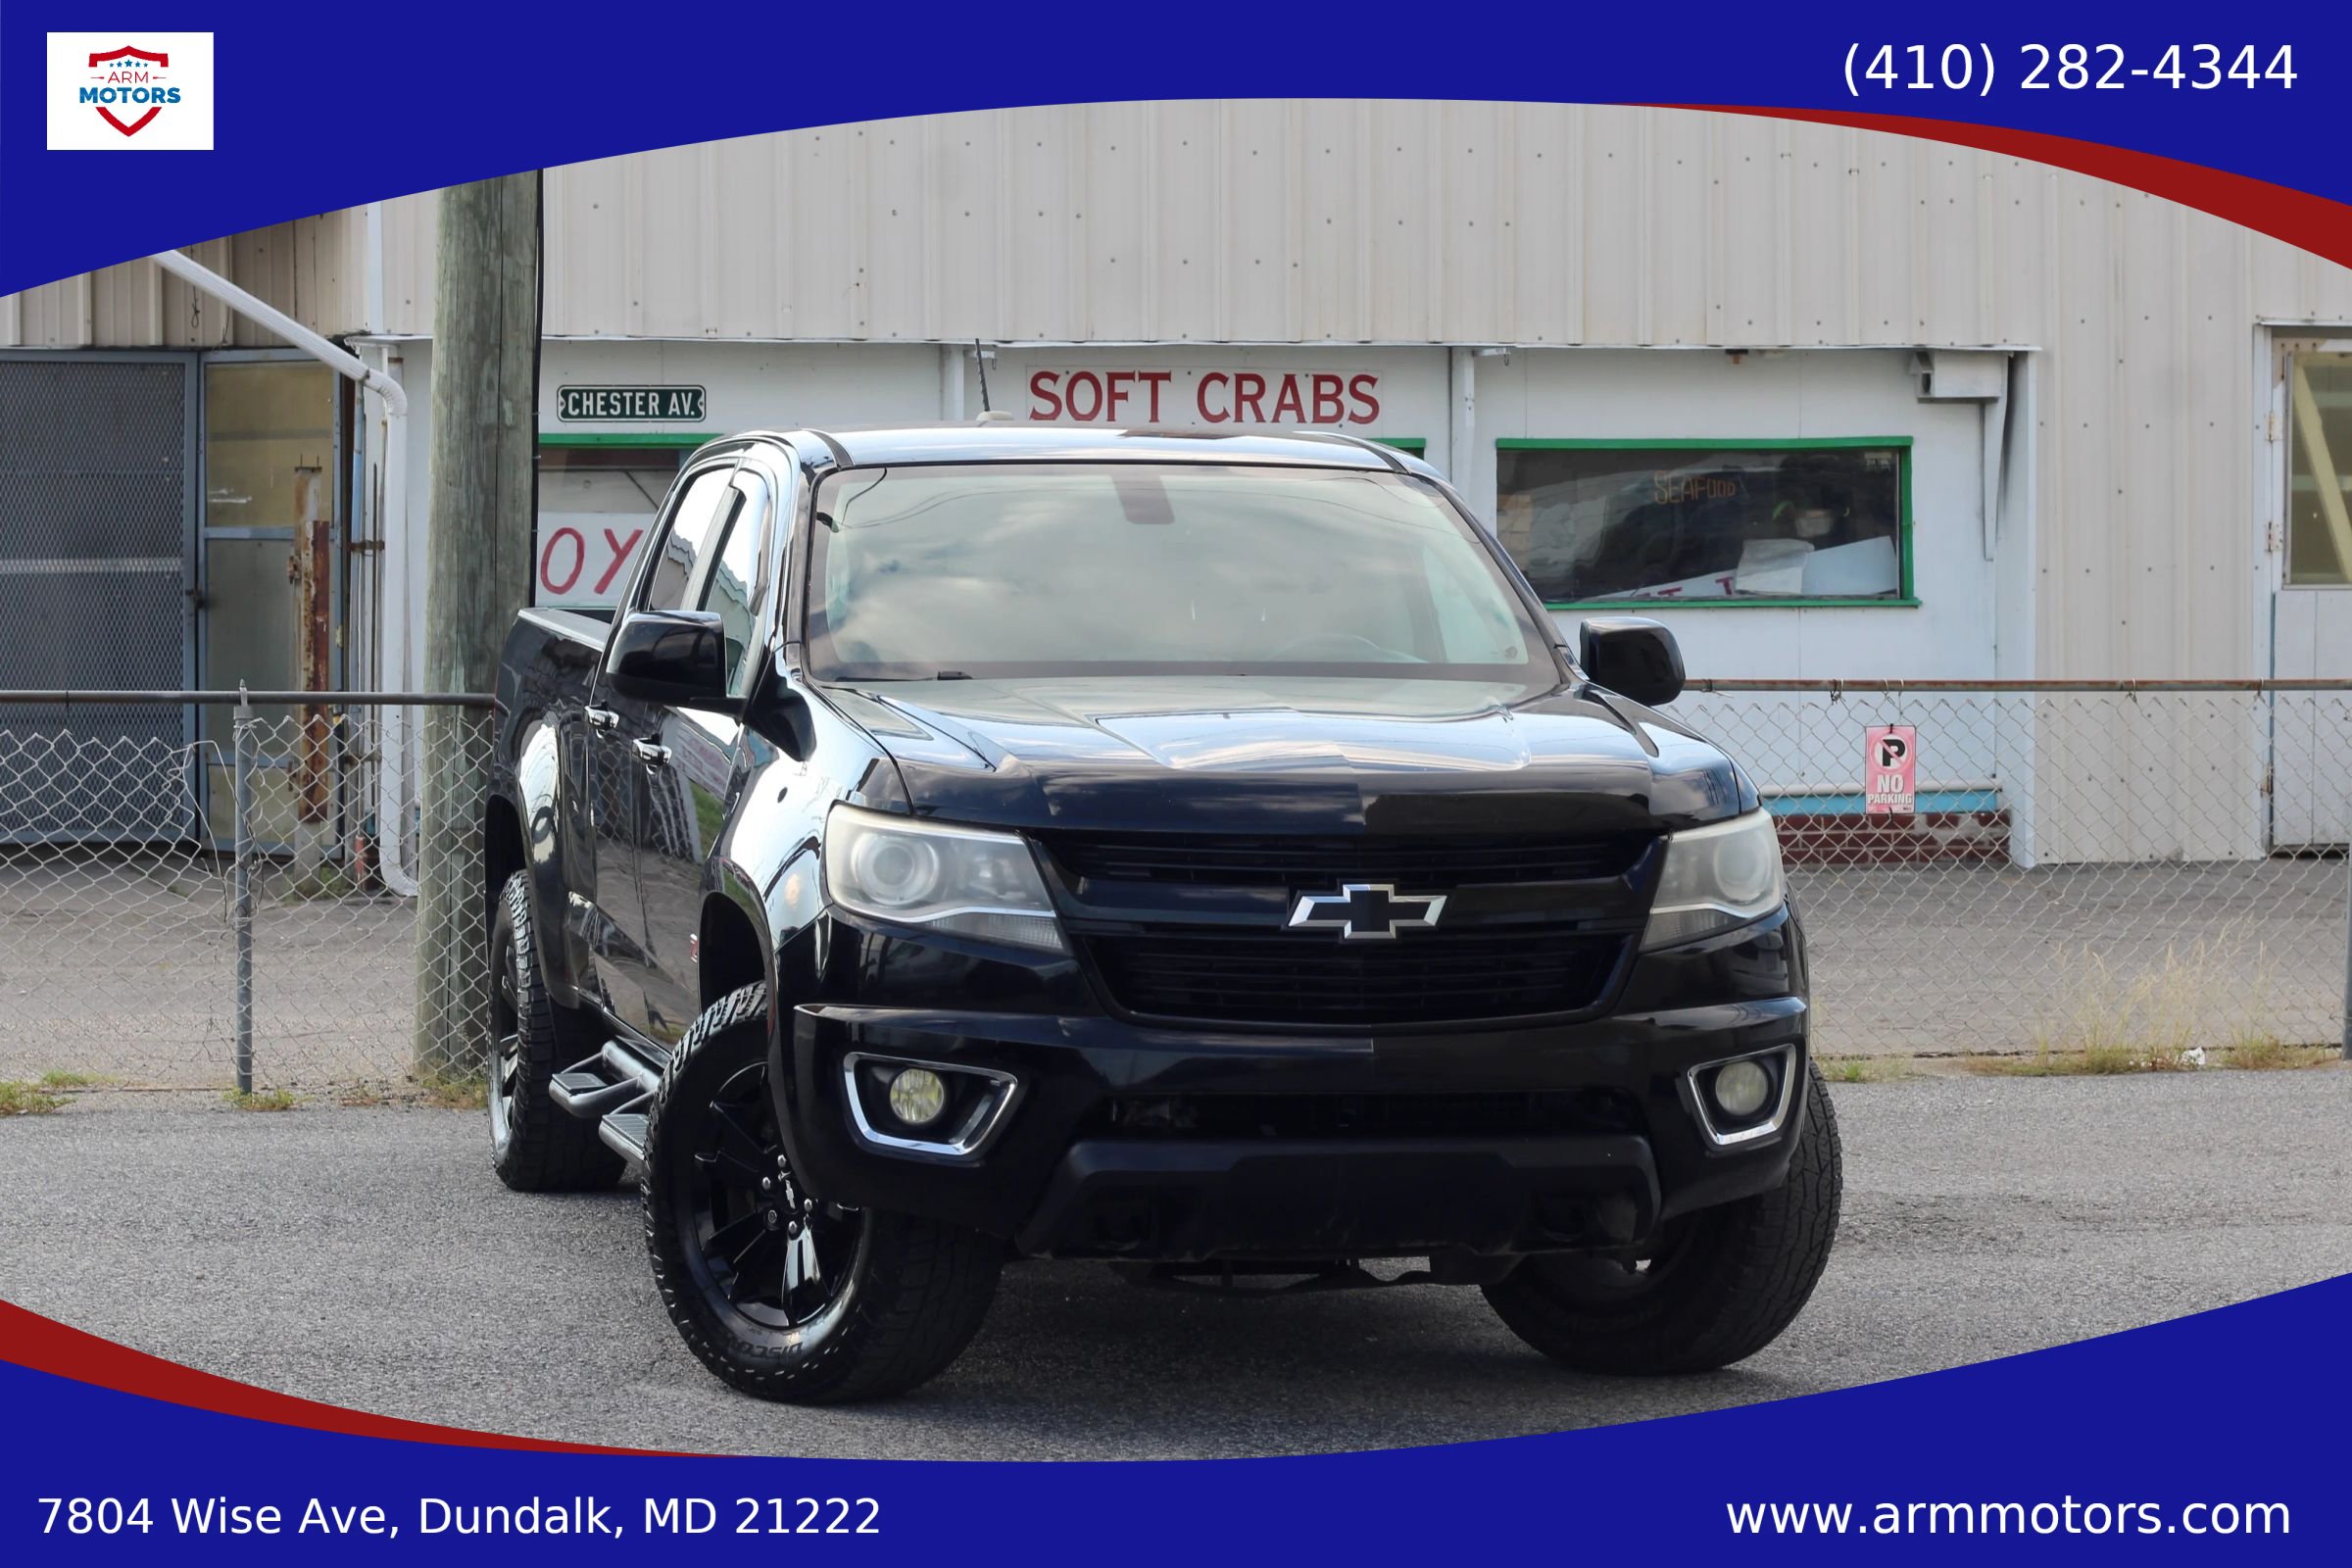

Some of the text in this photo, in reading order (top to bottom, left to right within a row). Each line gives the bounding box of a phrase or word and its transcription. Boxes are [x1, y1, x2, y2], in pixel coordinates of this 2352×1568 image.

[567, 392, 695, 416] CHESTER AV.
[1029, 370, 1381, 425] SOFT CRABS
[1653, 469, 1736, 505] SEAFOOD
[1877, 774, 1904, 794] NO
[1867, 793, 1913, 805] PARKING
